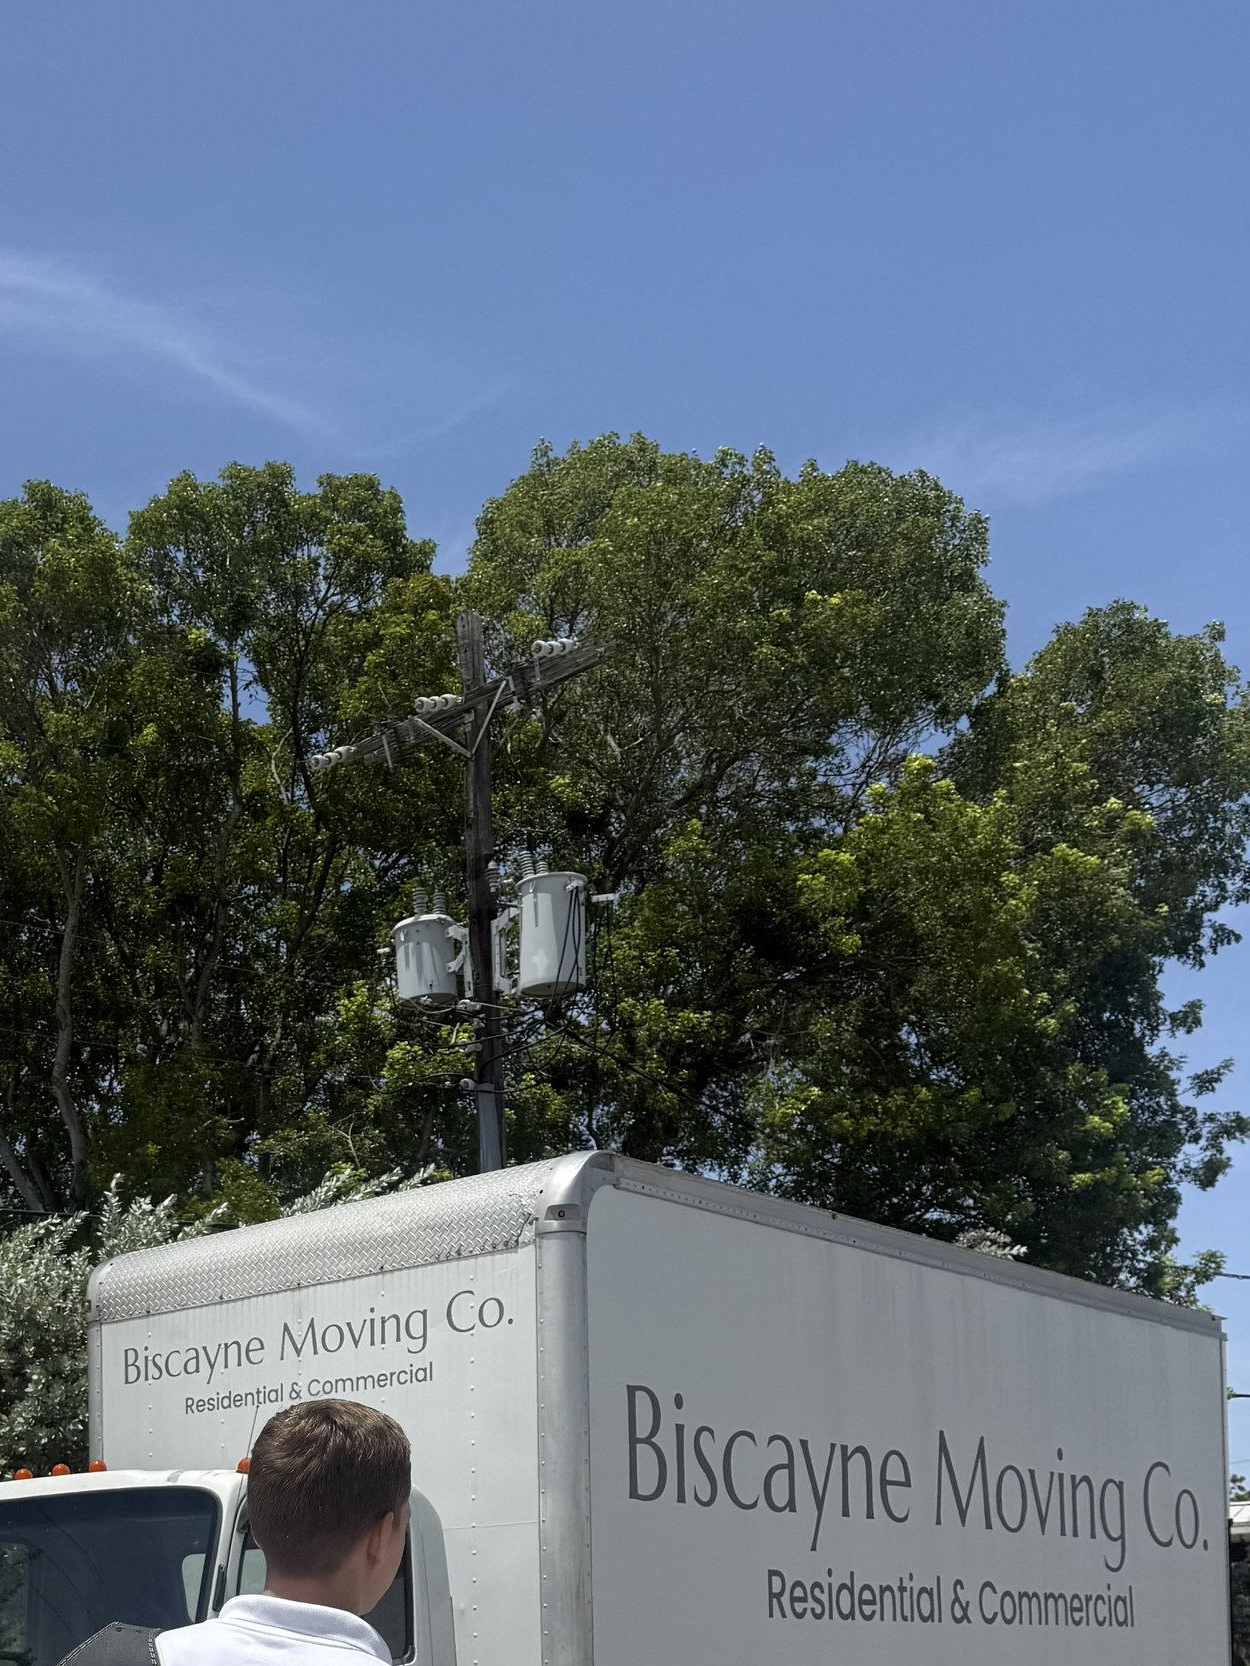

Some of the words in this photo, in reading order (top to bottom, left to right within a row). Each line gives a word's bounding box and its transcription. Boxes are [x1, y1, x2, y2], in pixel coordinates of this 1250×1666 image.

[123, 1336, 265, 1385] Biscayne
[279, 1307, 428, 1360] Moving
[445, 1290, 514, 1333] Co.
[184, 1383, 284, 1415] Residential
[289, 1382, 302, 1400] &
[307, 1361, 434, 1397] Commercial
[626, 1384, 912, 1552] Biscayne
[935, 1429, 1126, 1573] Moving
[1142, 1461, 1210, 1552] Co.
[767, 1568, 943, 1624] Residential
[950, 1578, 973, 1626] &
[979, 1580, 1135, 1628] Commercial
